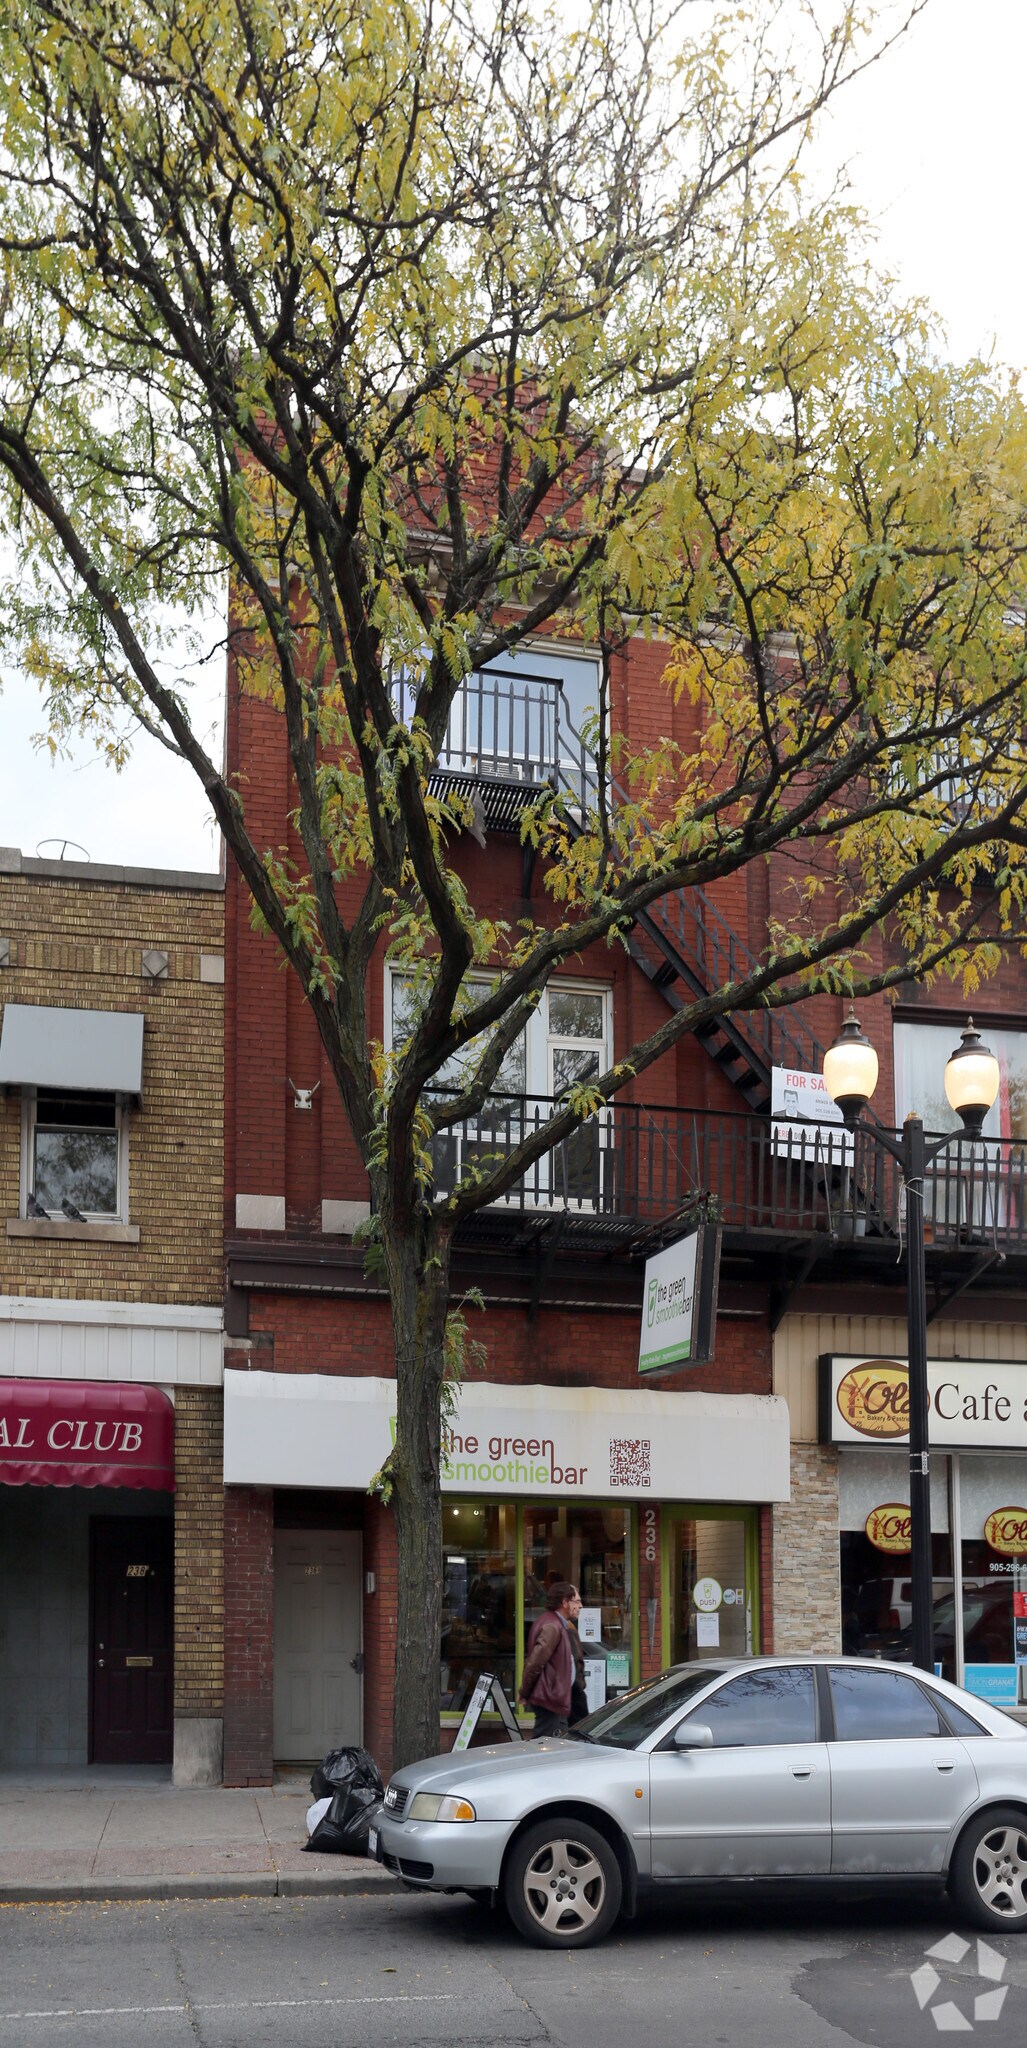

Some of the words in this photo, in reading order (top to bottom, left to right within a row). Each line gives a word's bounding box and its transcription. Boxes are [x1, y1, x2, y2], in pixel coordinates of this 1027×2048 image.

[786, 1074, 806, 1089] FOR
[810, 1078, 828, 1091] SA
[657, 1284, 667, 1303] the
[668, 1277, 686, 1303] green
[934, 1383, 1011, 1422] Cafe
[867, 1415, 886, 1423] Bakery
[47, 1420, 143, 1452] CLUB
[442, 1429, 479, 1454] the
[488, 1436, 555, 1461] green
[441, 1459, 588, 1485] smoothiebar
[645, 1509, 656, 1561] 236
[128, 1566, 146, 1576] 238
